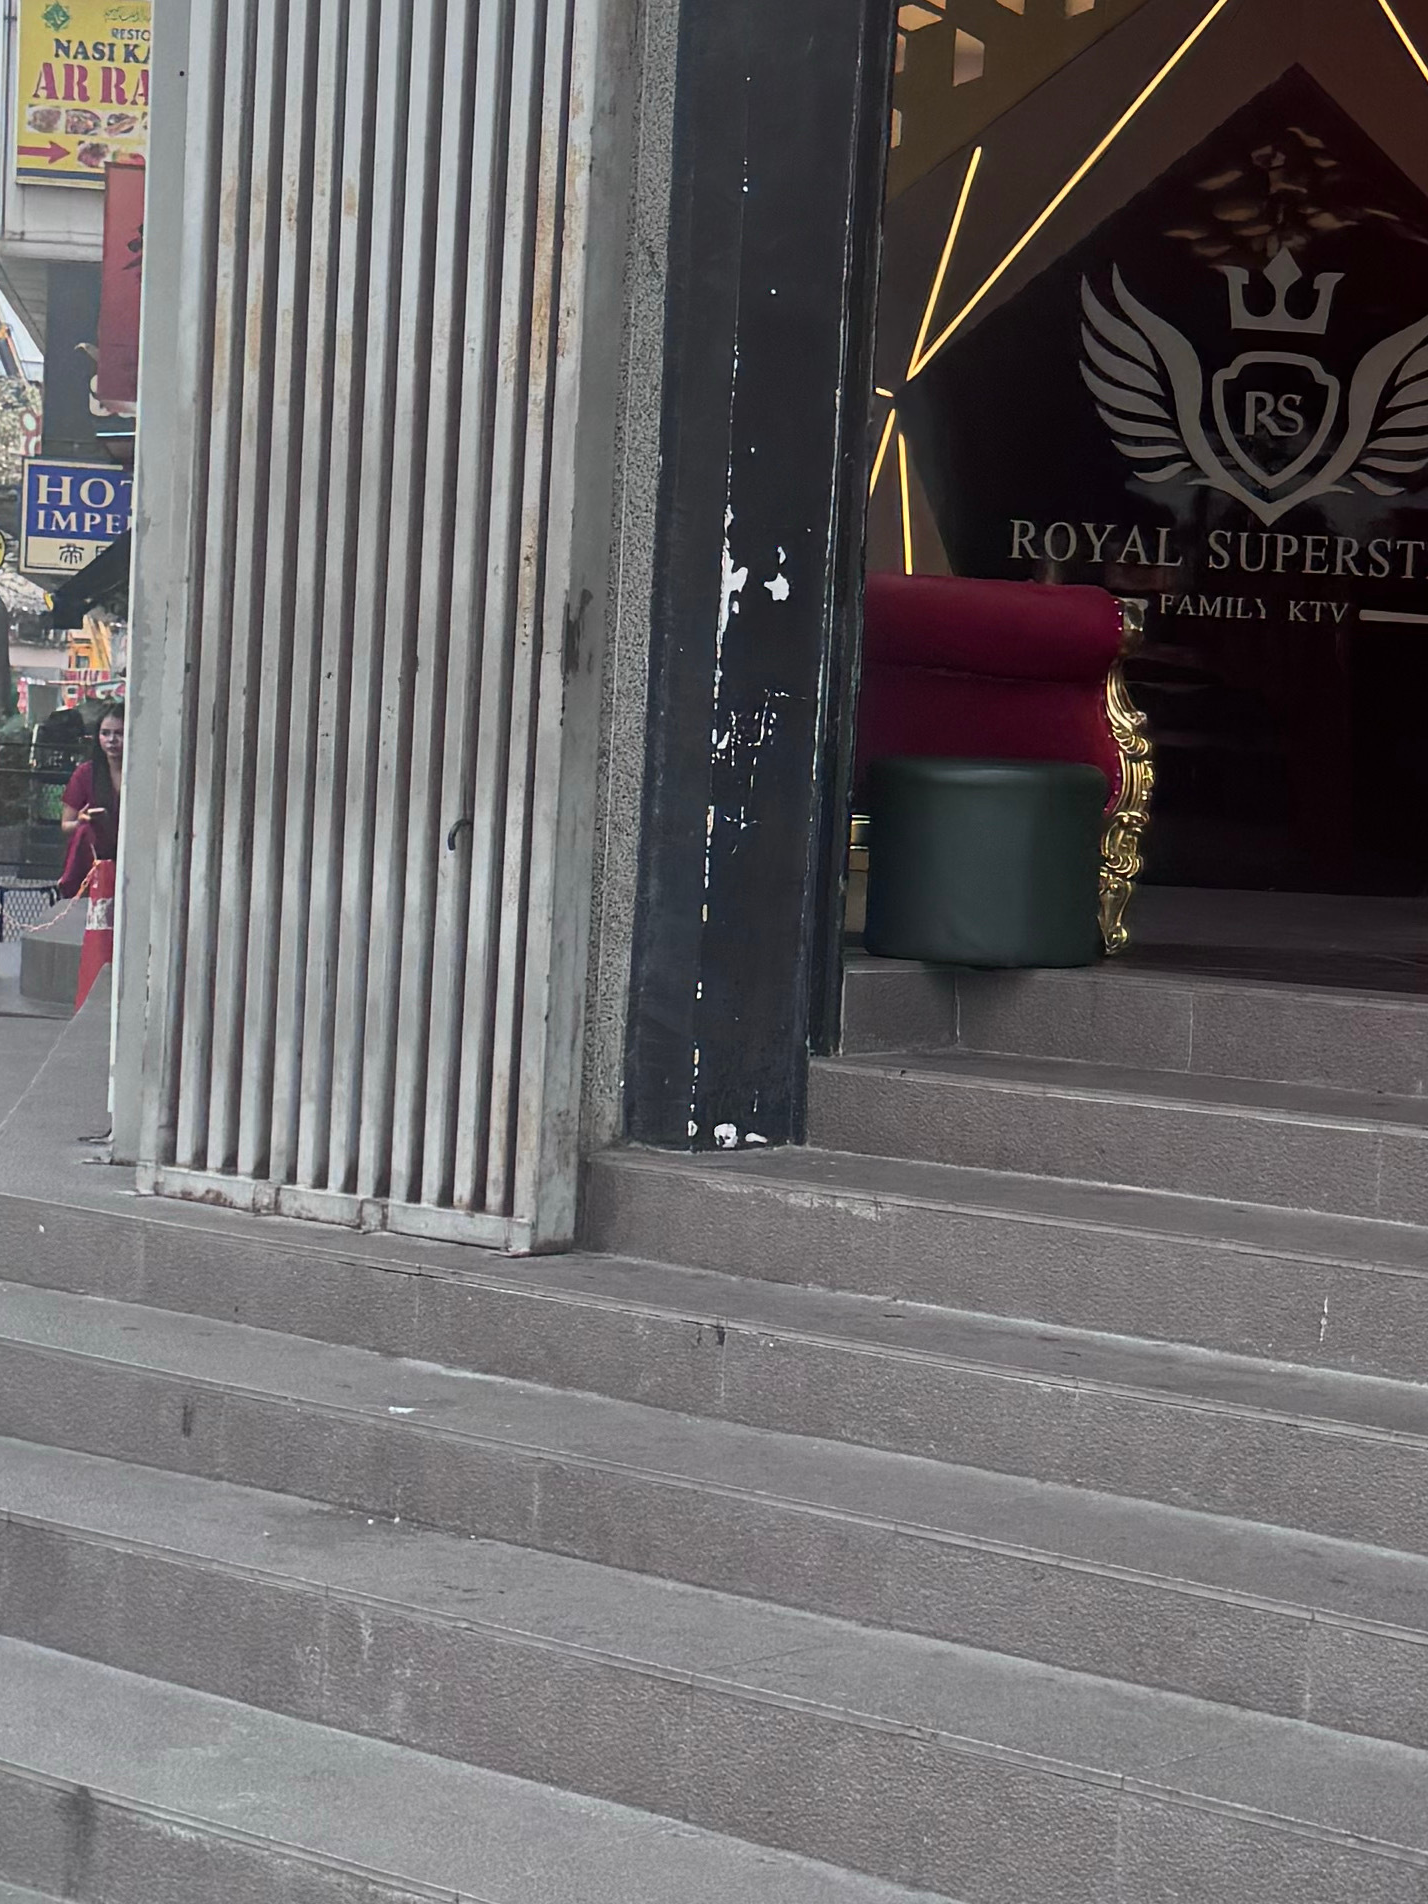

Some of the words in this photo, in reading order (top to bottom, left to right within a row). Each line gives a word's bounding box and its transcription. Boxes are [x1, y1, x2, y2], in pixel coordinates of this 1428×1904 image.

[54, 38, 116, 62] NASI
[1244, 390, 1304, 436] RS
[1007, 518, 1182, 568] ROYAL
[1159, 593, 1267, 620] FAMILY
[1288, 600, 1350, 623] KTV
